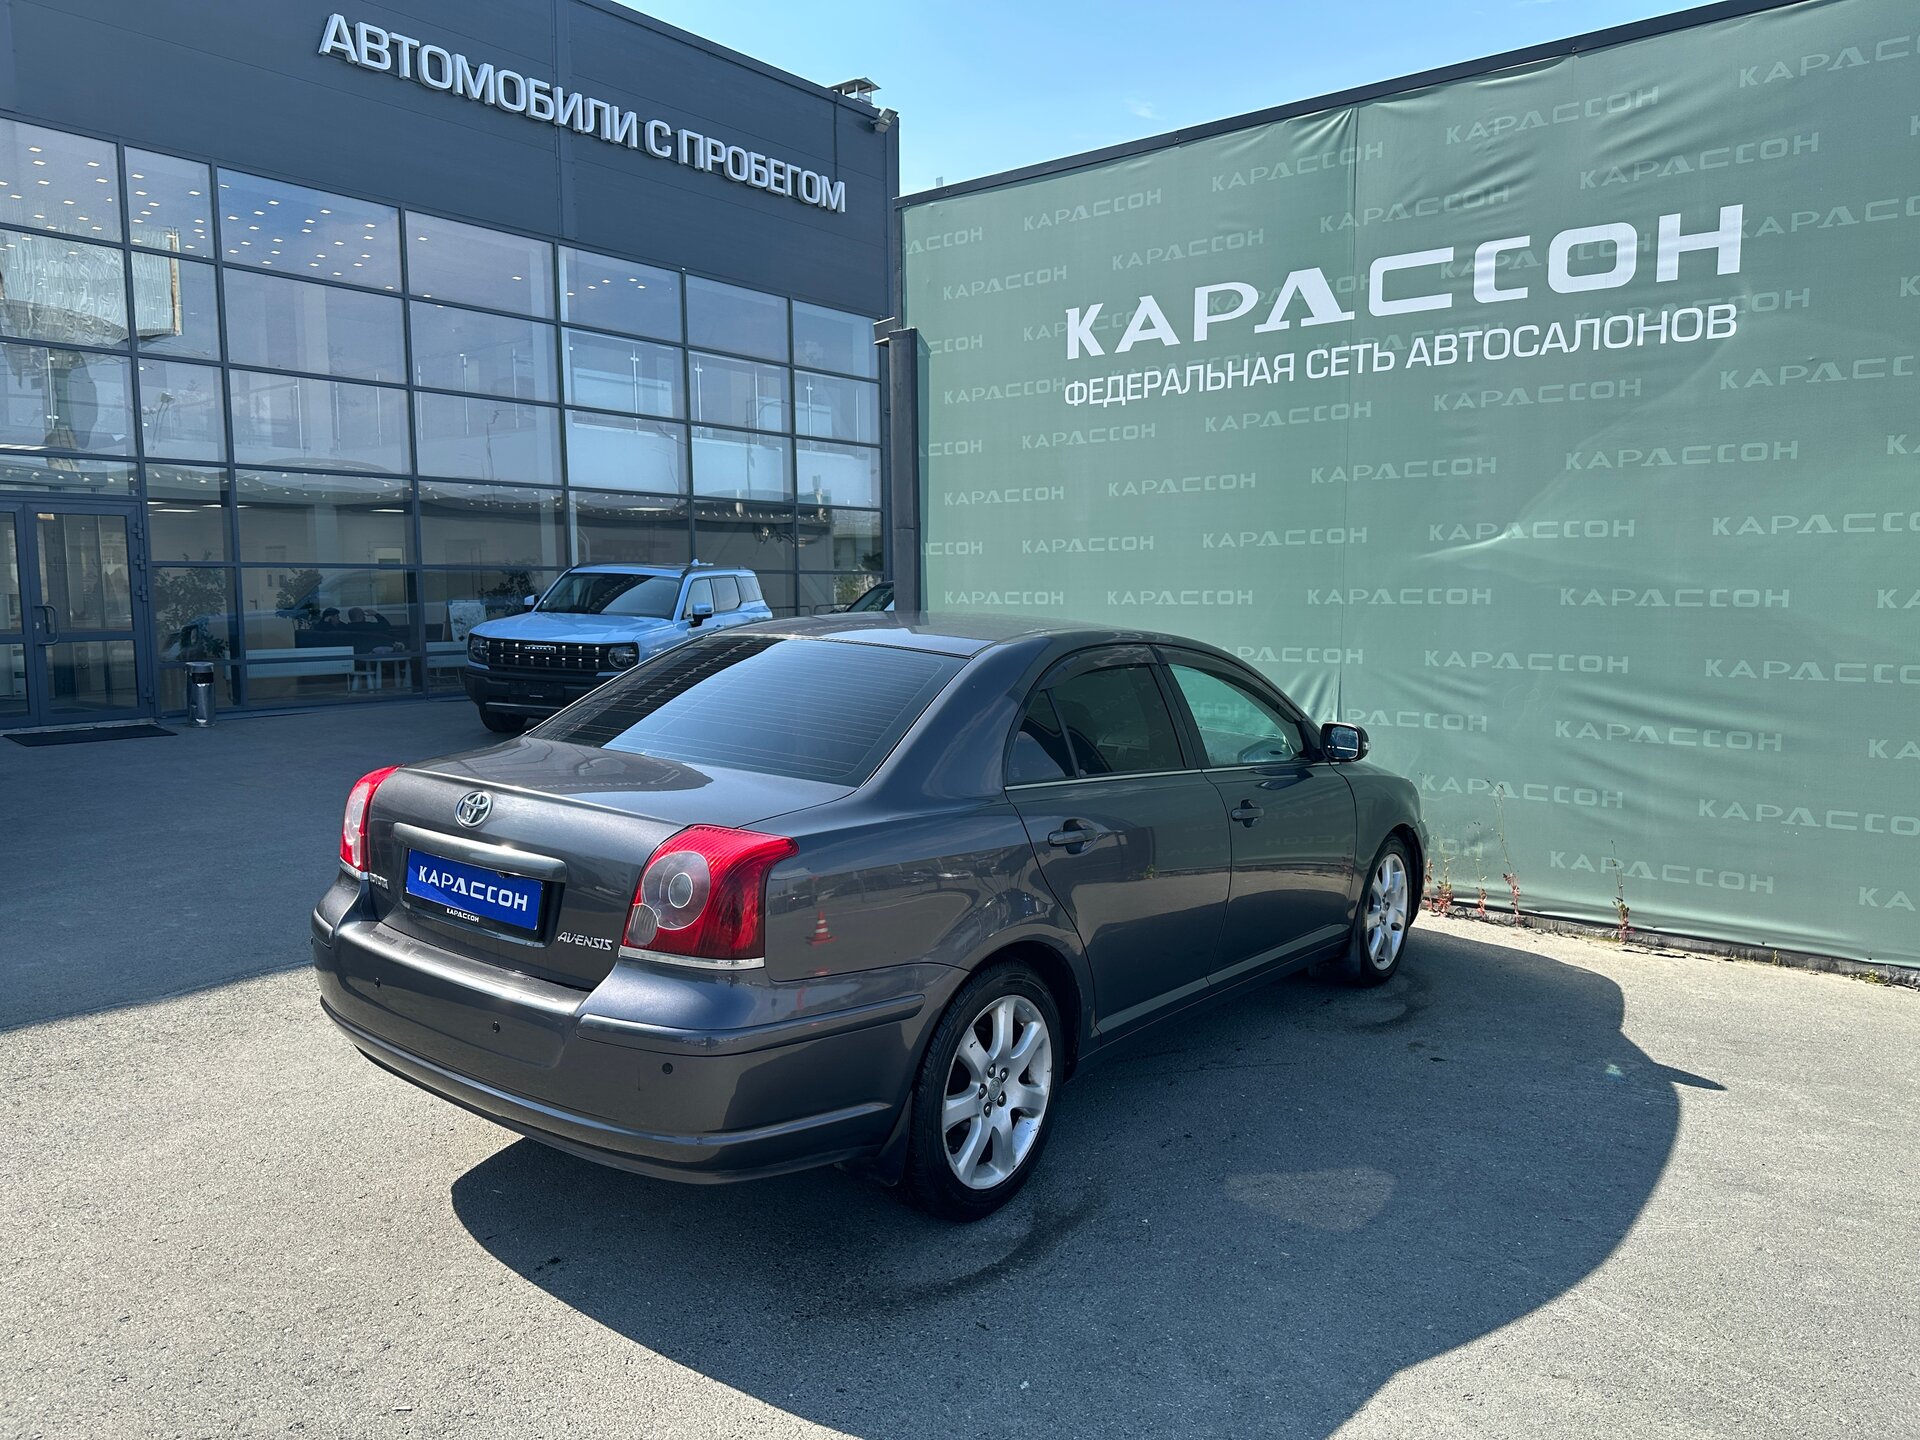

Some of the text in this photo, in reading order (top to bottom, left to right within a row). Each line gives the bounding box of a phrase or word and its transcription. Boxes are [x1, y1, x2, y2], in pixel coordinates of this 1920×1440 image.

[1739, 34, 1920, 89] КАРАС
[318, 13, 846, 214] АВТОМОБИЛИ С ПРОБЕГОМ
[1446, 86, 1660, 145] КАРАССОН
[1212, 140, 1384, 192] КАРАССОН
[1579, 132, 1820, 191] КАРАССОН
[1023, 188, 1162, 232] КАРАССОН
[1319, 185, 1510, 235] КАРАССОН
[1112, 228, 1265, 272] КАРАССОН
[943, 265, 1068, 301] КАРАССОН
[1065, 204, 1744, 360] КАРАССОН
[1064, 303, 1739, 409] ФЕДЕРАЛЬНАЯ СЕТЬ АВТОСАЛОНОВ
[943, 377, 1067, 406] КАРАССОН
[1433, 378, 1643, 412] КАРАССОН
[1205, 401, 1373, 433] КАРАССОН
[1022, 422, 1156, 450] КАРАССОН
[1311, 456, 1497, 485] КАРАССОН
[1565, 439, 1799, 471] КАРАССОН
[944, 486, 1065, 506] КАРАССОН
[1108, 473, 1257, 498] КАРАССОН
[1022, 535, 1155, 554] КАРАССОН
[1202, 527, 1368, 550] КАРАССОН
[1429, 518, 1636, 542] КАРАССОН
[944, 590, 1064, 606] КАРАССОН
[1107, 590, 1254, 606] КАРАССОН
[1307, 587, 1492, 606] КАРАССОН
[1560, 587, 1790, 609] КАРАССОН
[1424, 649, 1630, 674] КАРАССОН
[1555, 719, 1782, 753] КАРАССОН
[418, 864, 529, 912] КАРАССОН
[1549, 850, 1775, 895] КАРАССОН
[446, 907, 480, 923] КАРАССОН
[557, 931, 613, 951] AVENSIS
